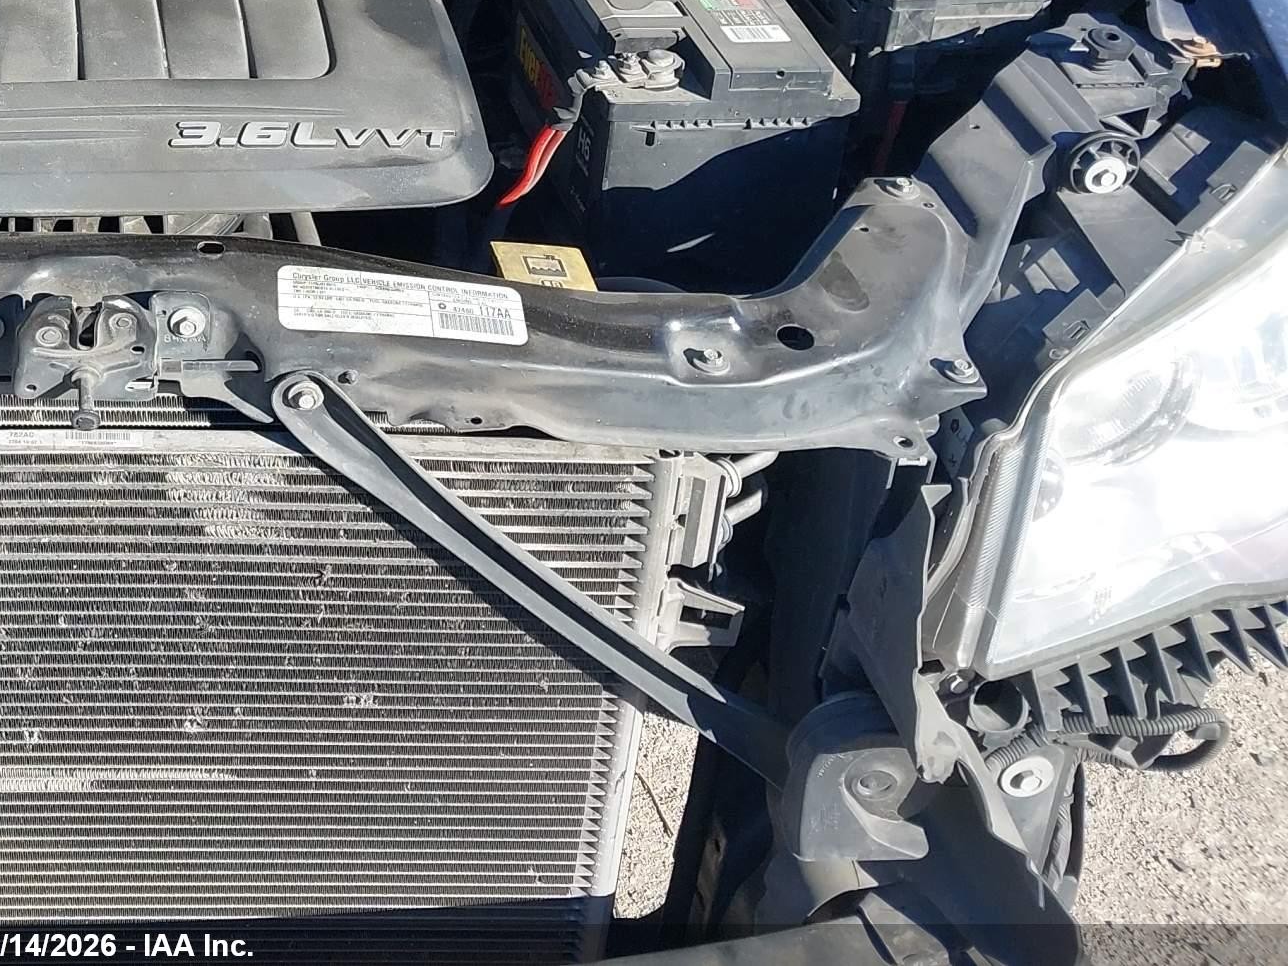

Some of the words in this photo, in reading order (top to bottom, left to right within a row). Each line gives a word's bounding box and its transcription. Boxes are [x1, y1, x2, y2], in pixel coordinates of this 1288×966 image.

[292, 272, 321, 282] Chrysler
[324, 274, 344, 283] Group
[347, 276, 360, 284] LLC
[363, 277, 390, 287] VEHICLE
[393, 281, 426, 290] EMISSION
[428, 284, 458, 294] CONTROL
[461, 289, 508, 299] INFORMATION
[479, 305, 511, 319] 117AA
